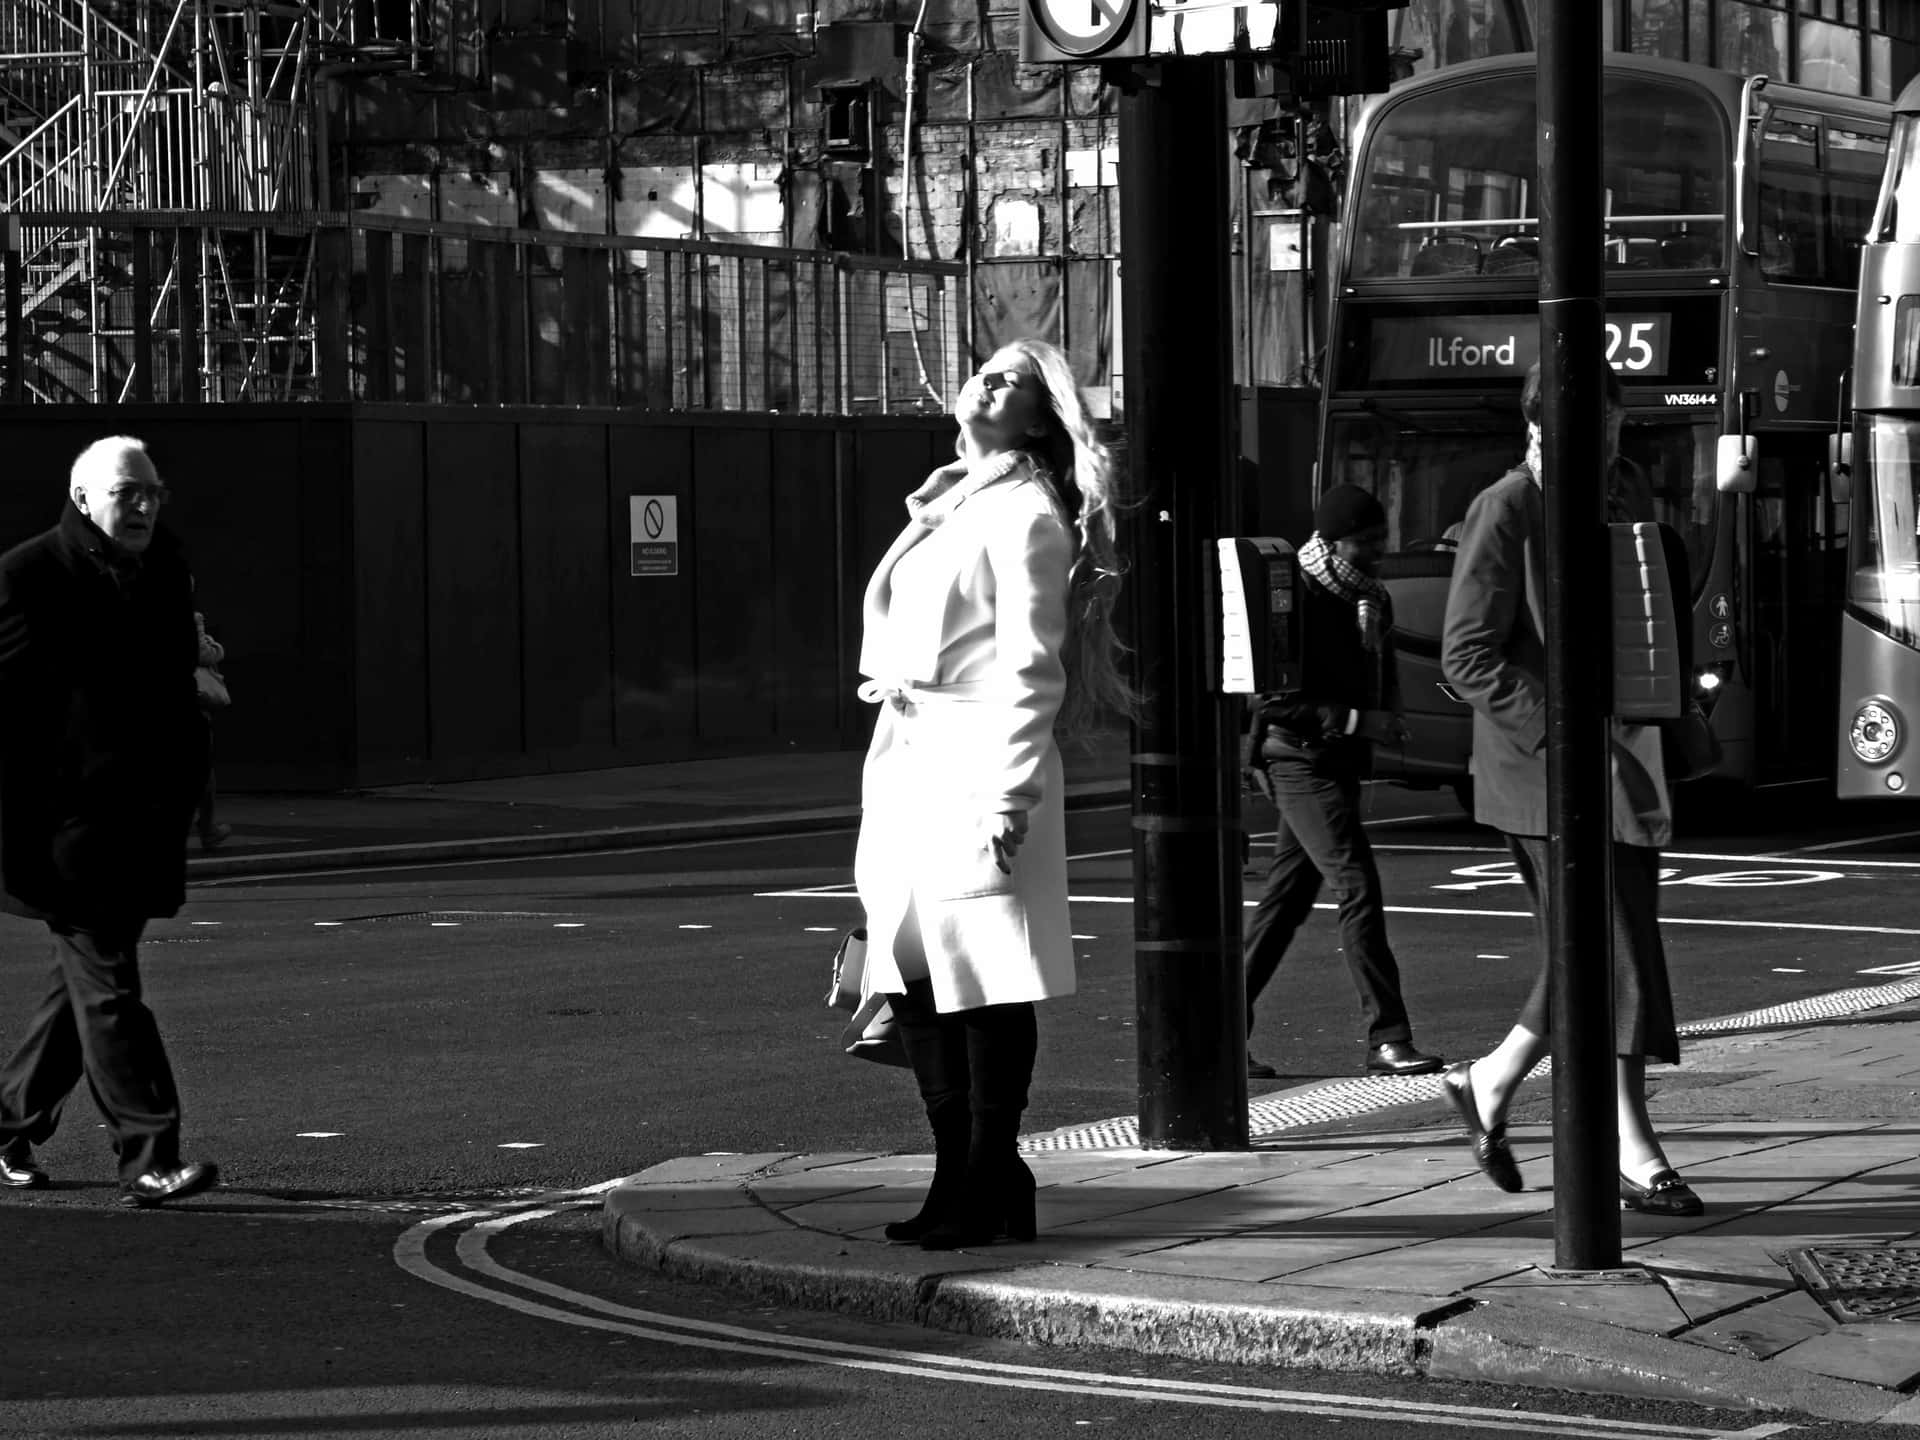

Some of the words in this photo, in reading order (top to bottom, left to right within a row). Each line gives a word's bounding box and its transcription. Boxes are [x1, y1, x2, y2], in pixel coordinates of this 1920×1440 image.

[1428, 335, 1515, 367] Ilford
[1604, 322, 1654, 370] 25
[1664, 393, 1717, 405] VN36144
